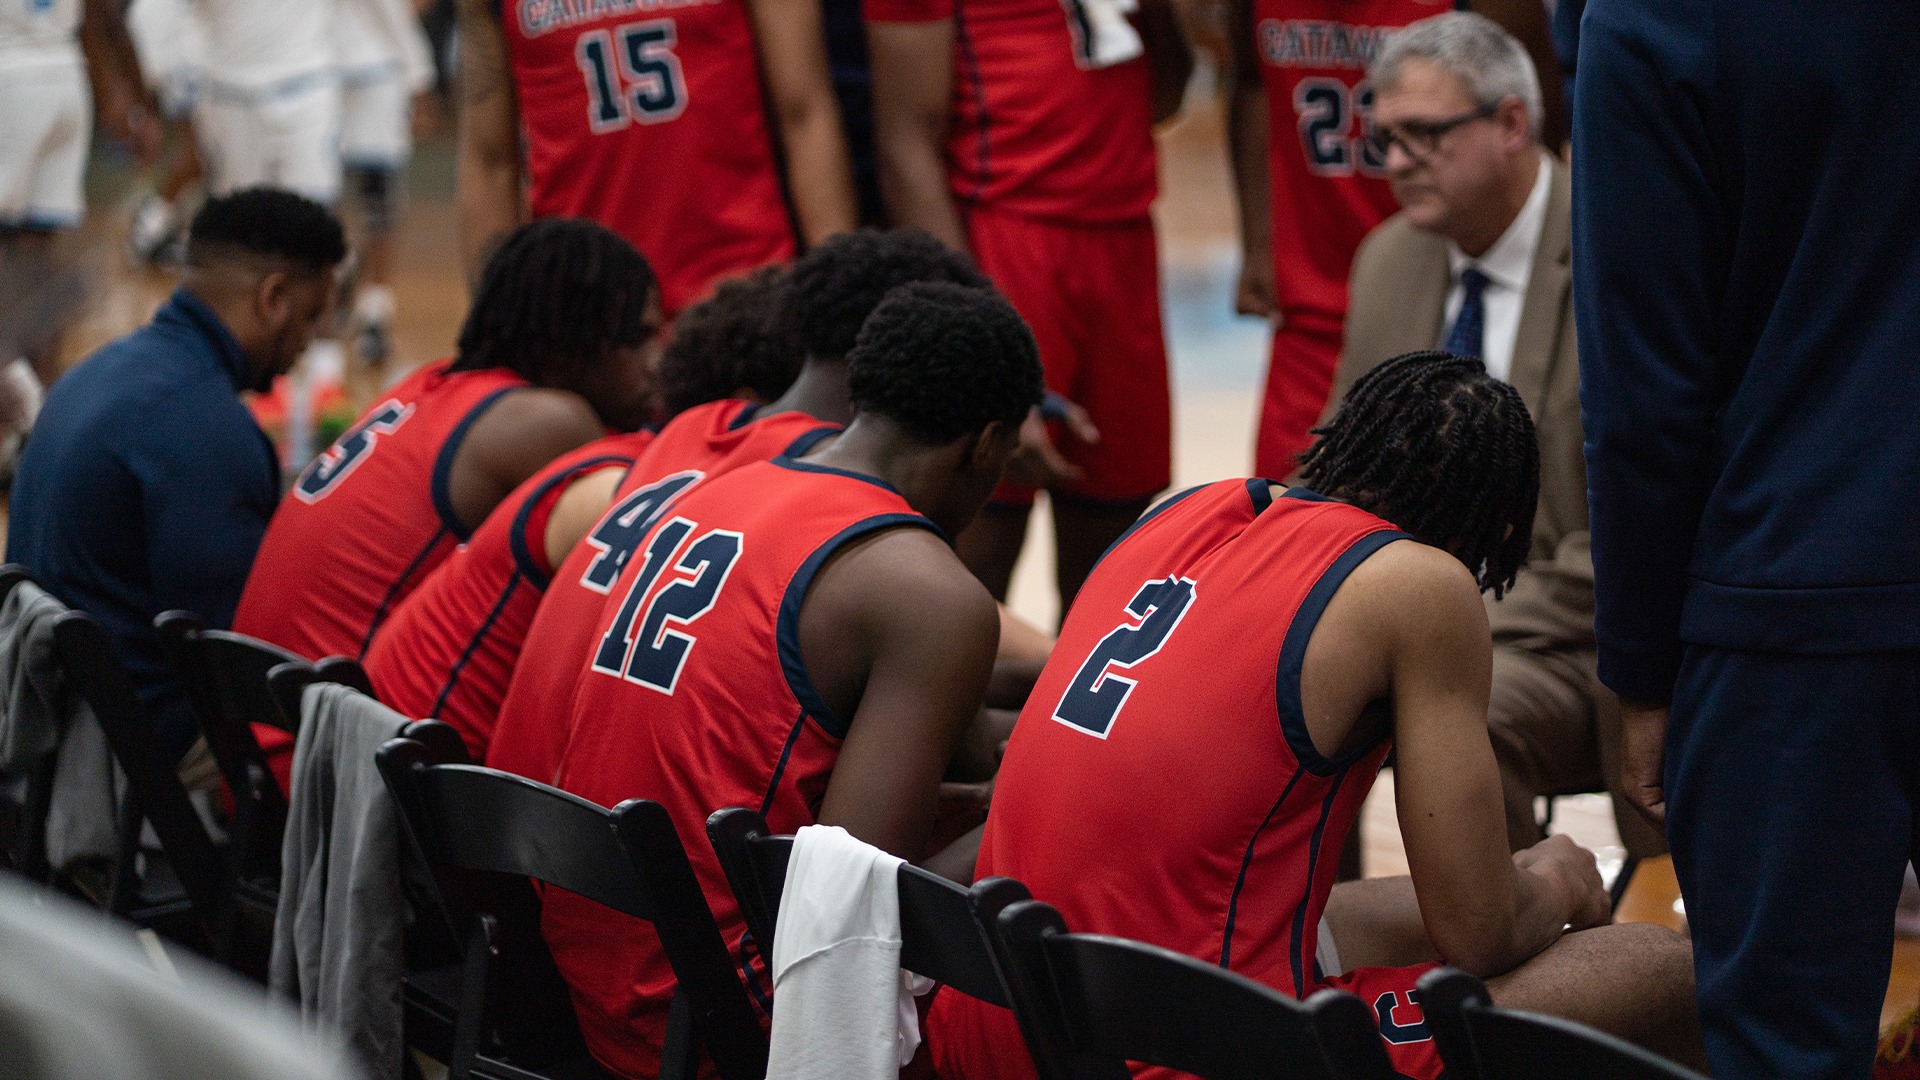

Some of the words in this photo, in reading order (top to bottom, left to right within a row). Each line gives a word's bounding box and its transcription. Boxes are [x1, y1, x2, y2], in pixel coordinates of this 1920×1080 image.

[516, 0, 724, 38] CATA
[574, 17, 689, 135] 15
[1257, 18, 1393, 69] CATAW
[293, 398, 416, 505] 5
[579, 469, 706, 596] 4
[591, 515, 744, 697] 12
[1051, 573, 1198, 741] 2
